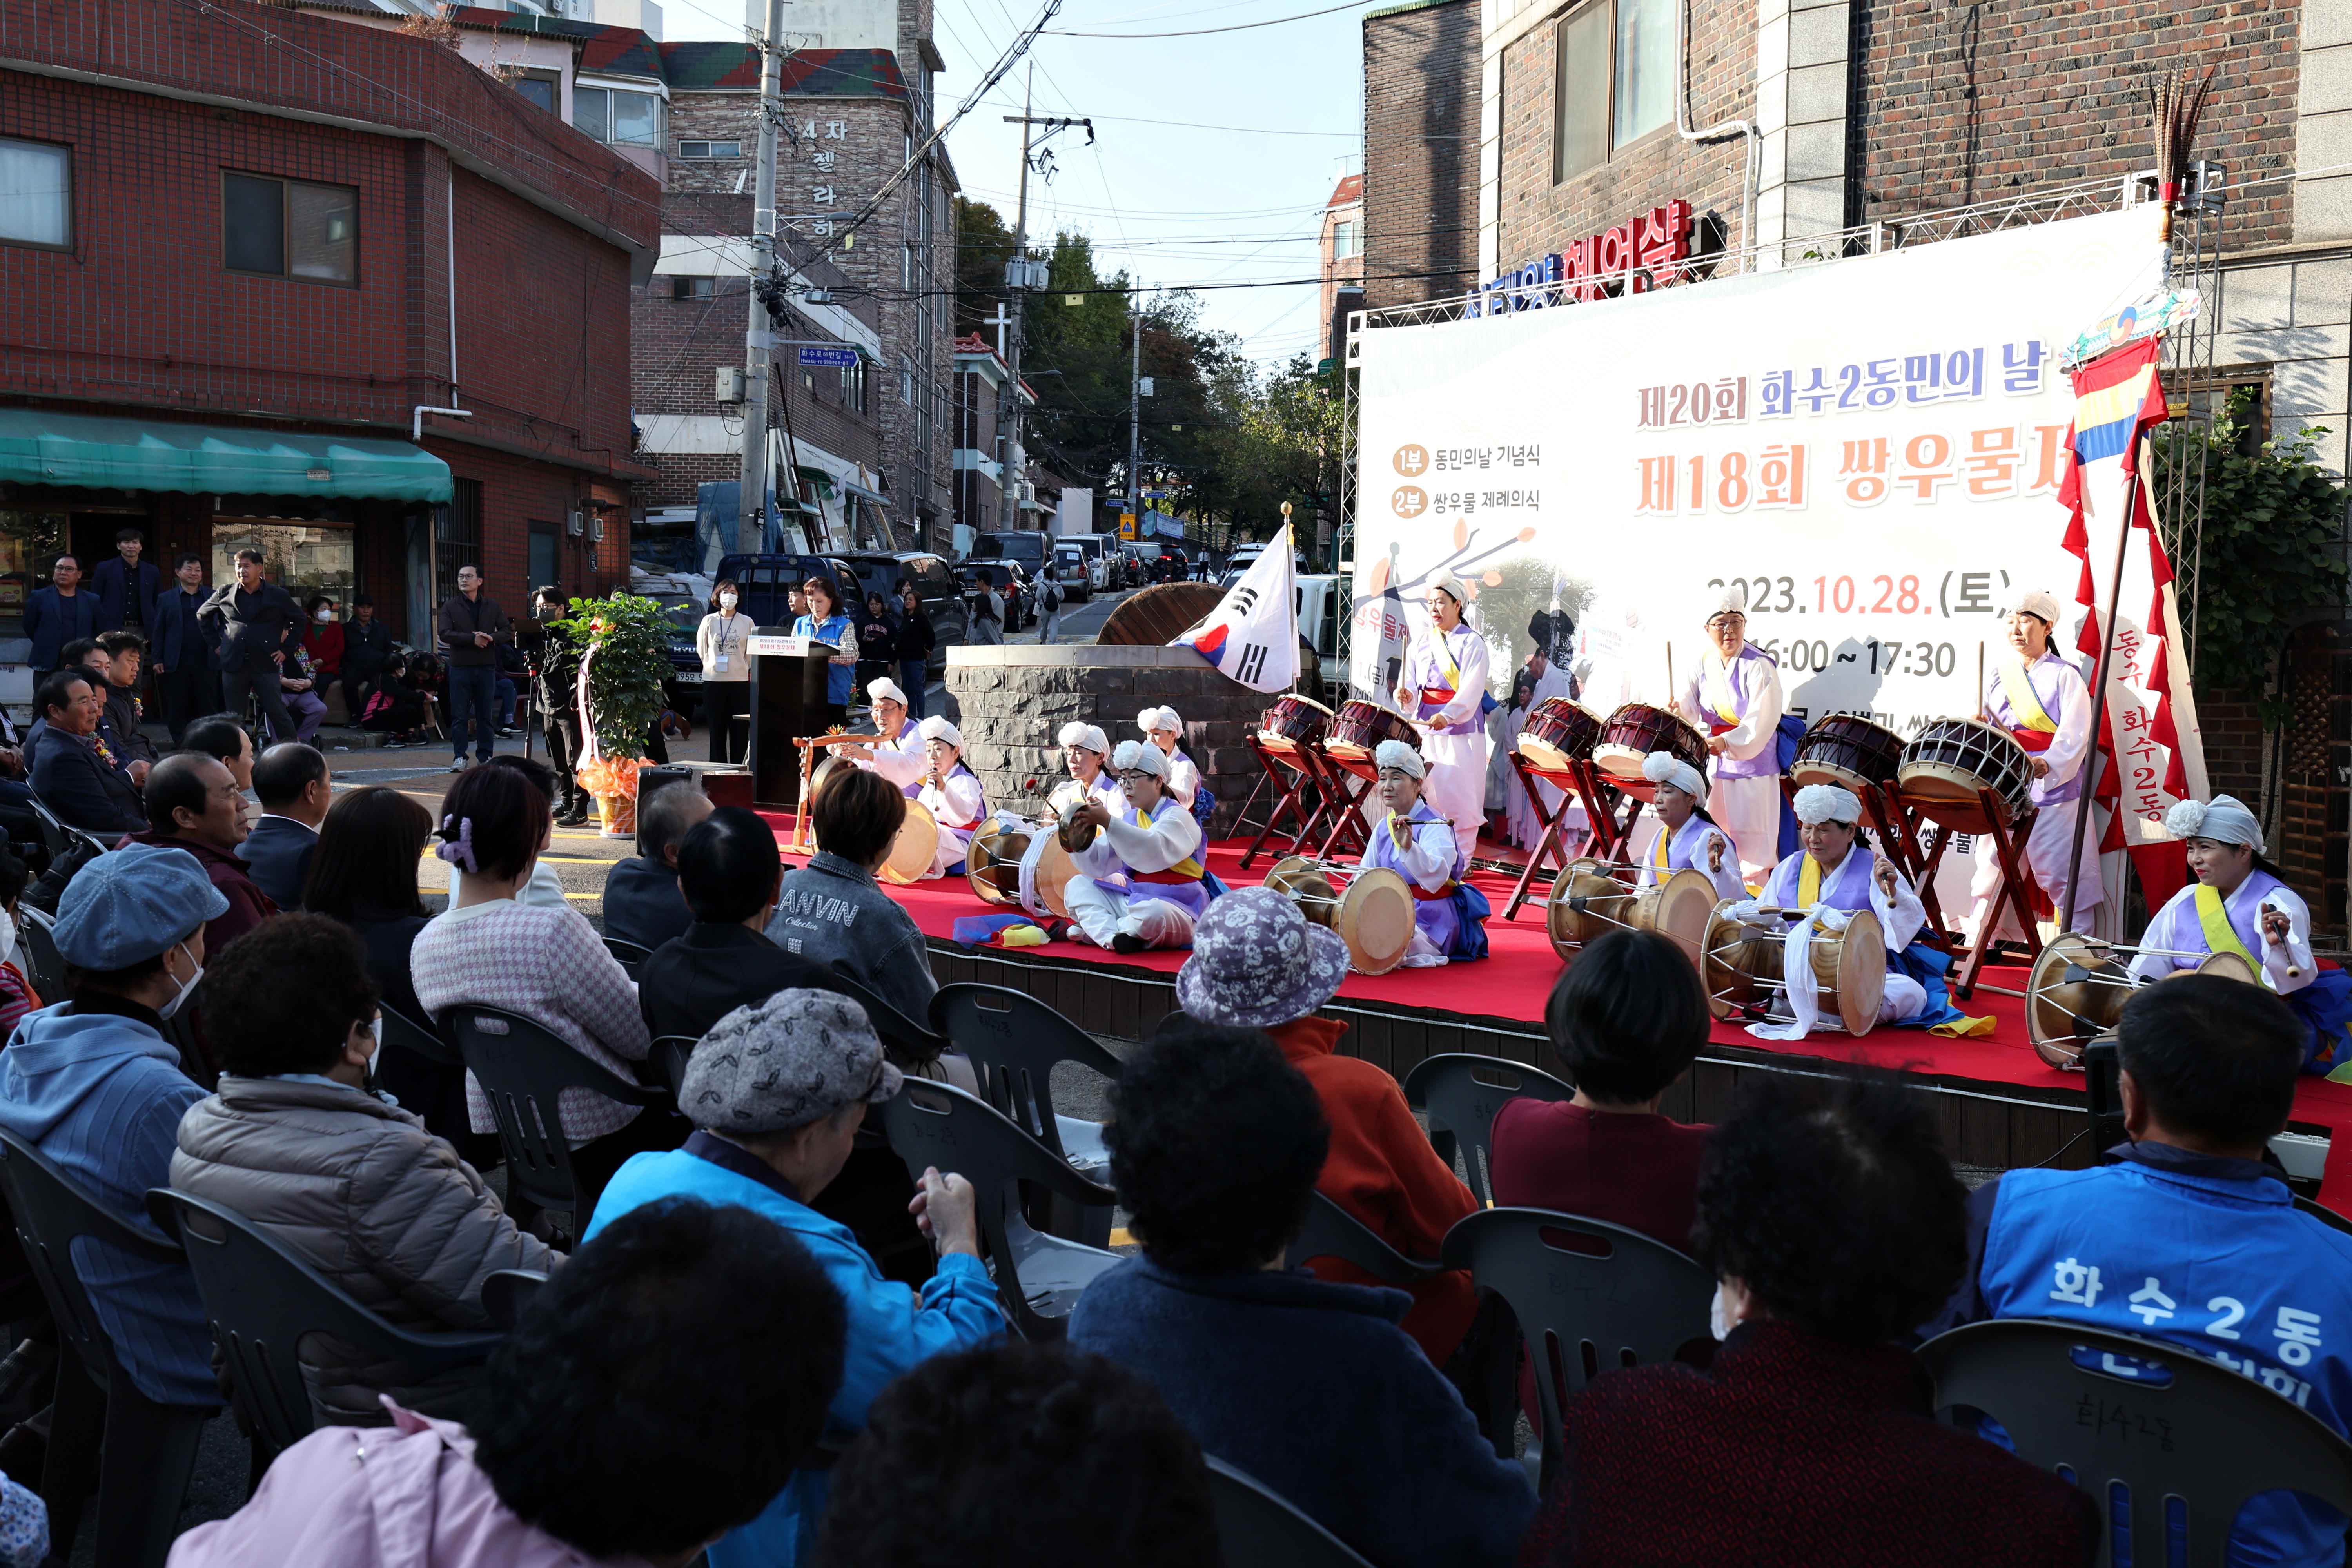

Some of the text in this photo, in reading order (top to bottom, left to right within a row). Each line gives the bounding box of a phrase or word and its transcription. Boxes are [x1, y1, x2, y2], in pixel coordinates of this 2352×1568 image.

[802, 120, 848, 142] 4차
[1563, 199, 1691, 303] 헤어샵
[1637, 340, 2047, 428] 제20회 화수2동민의 날
[1399, 444, 1540, 473] 1부 동민의날 기념식
[1637, 444, 1805, 511] 제18회
[1396, 489, 1539, 514] 2부 쌍우물 제례의식
[865, 624, 887, 635] PARIS
[1751, 639, 1828, 672] 6:00
[1867, 641, 1956, 677] 17:30
[2111, 630, 2143, 686] 동구
[2122, 706, 2166, 822] 화수2동
[773, 889, 859, 927] ANVIN
[785, 916, 818, 931] Collection
